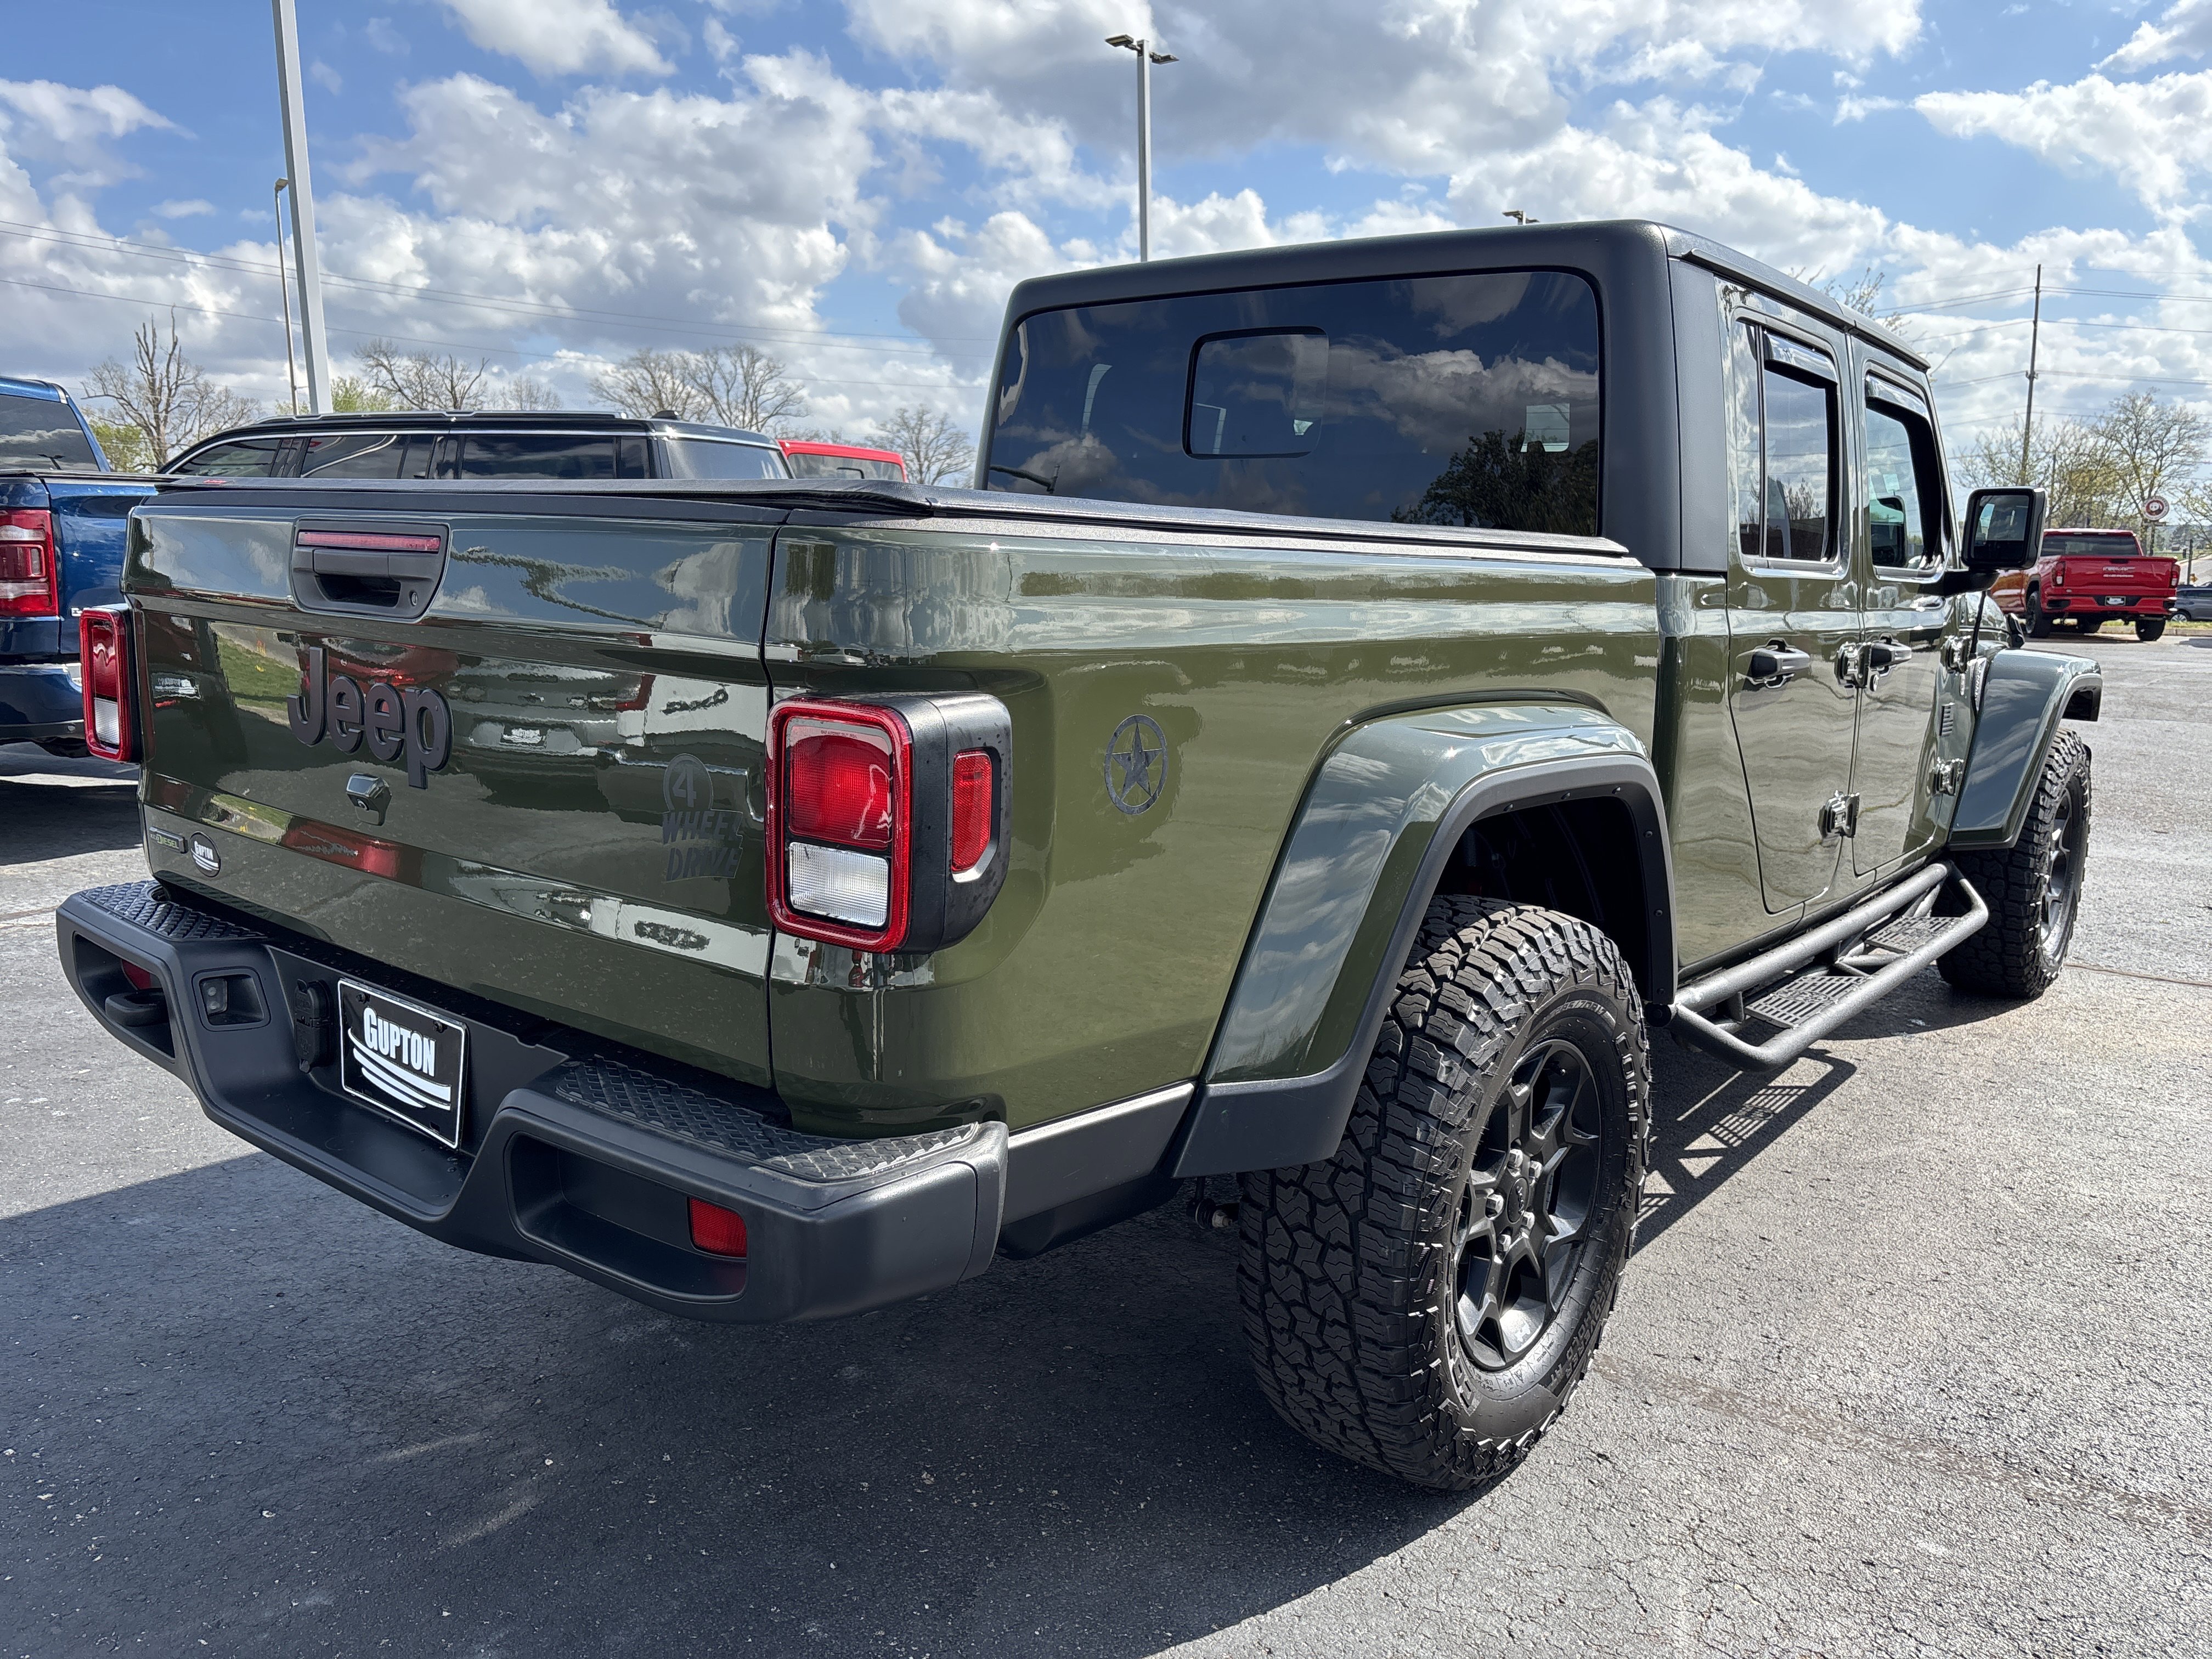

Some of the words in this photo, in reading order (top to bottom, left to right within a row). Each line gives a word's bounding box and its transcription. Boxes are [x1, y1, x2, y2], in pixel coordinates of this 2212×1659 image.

[287, 647, 454, 789] Jeep
[672, 769, 697, 808] 4
[194, 840, 213, 860] GUPTON
[663, 810, 742, 845] WHEEL
[665, 848, 741, 882] DRIVE
[363, 1007, 436, 1077] GUPTON
[1616, 1032, 1639, 1209] COOPER
[1565, 1256, 1618, 1380] DISCOVERER
